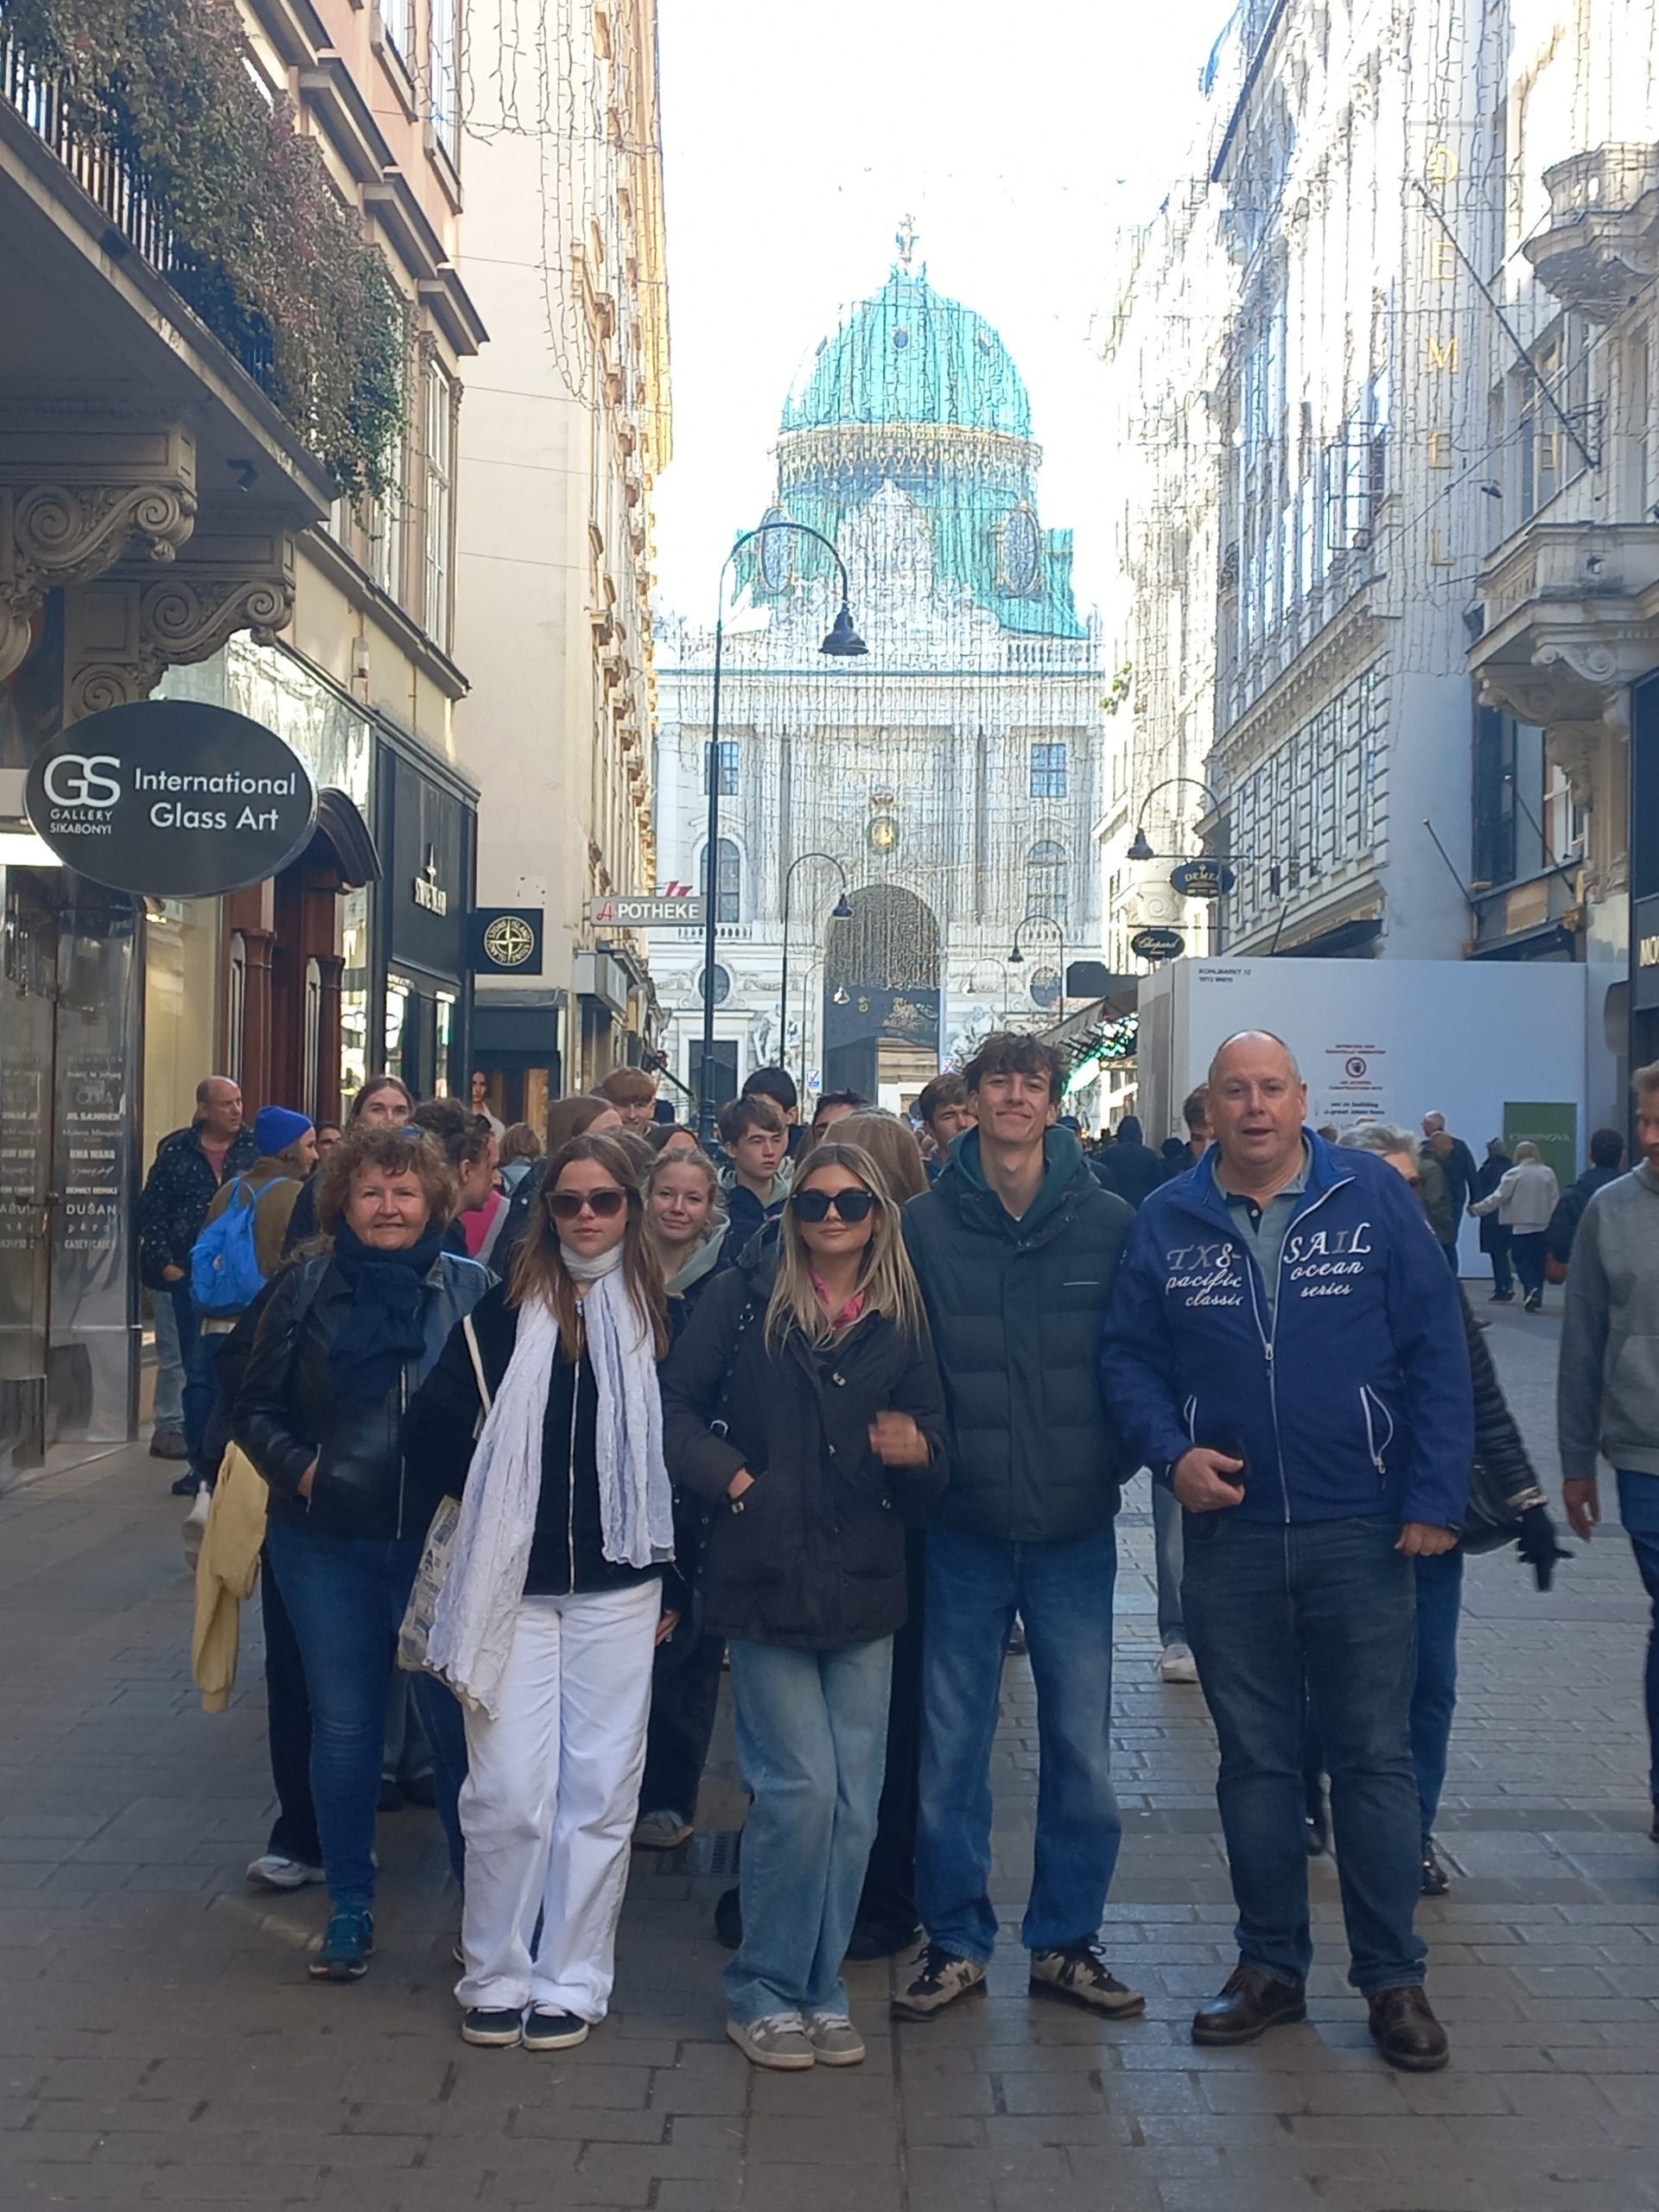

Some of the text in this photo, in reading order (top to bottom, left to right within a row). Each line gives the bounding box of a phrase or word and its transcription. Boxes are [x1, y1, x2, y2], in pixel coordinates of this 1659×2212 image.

[44, 754, 121, 807] GS
[134, 767, 296, 796] International
[49, 808, 113, 822] GALLERY
[49, 822, 112, 836] SIKABONYI
[149, 802, 279, 831] Glass Art
[1283, 1222, 1371, 1264] SAIL
[1166, 1262, 1364, 1295] pacific ocean
[1185, 1281, 1353, 1306] classic series
